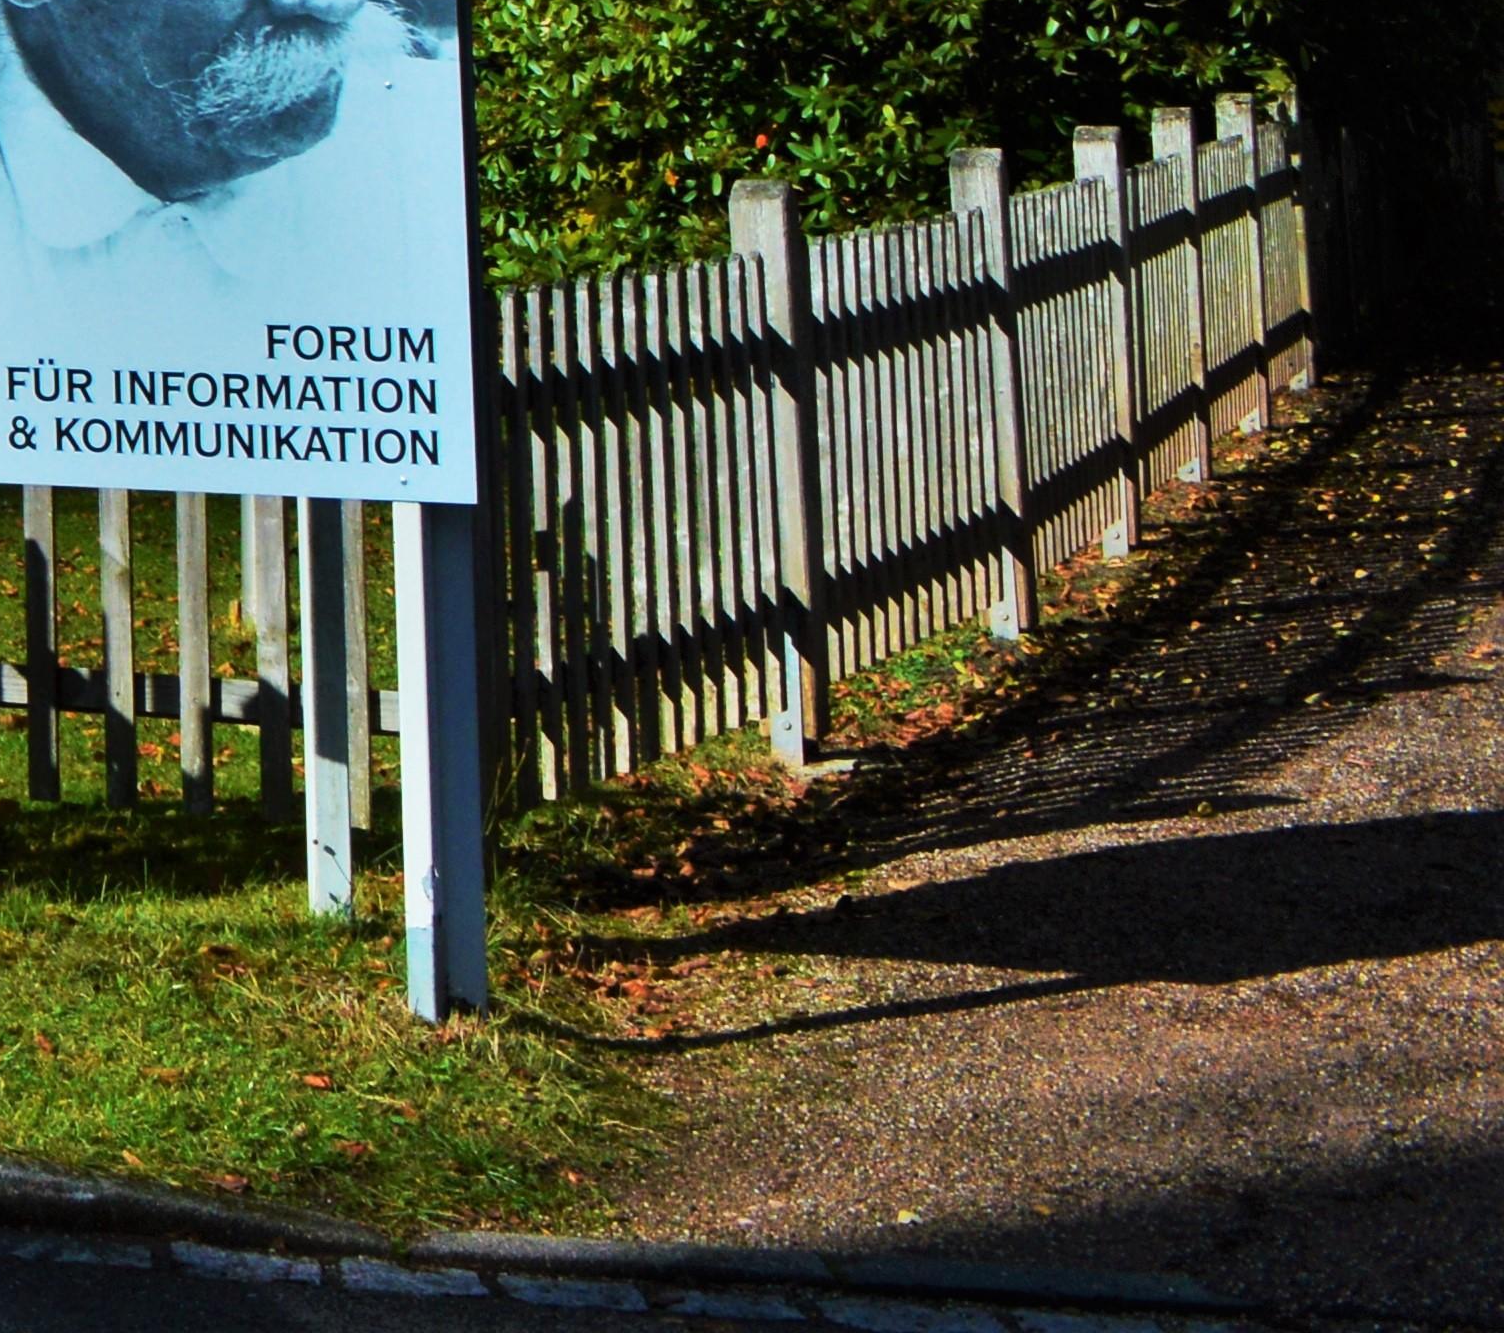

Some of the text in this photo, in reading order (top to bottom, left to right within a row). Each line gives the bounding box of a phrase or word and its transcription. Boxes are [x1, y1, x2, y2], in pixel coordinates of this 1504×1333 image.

[266, 324, 435, 363] FORUM
[6, 358, 438, 414] FÜR INFORMATION
[8, 415, 440, 465] & KOMMUNIKATION
